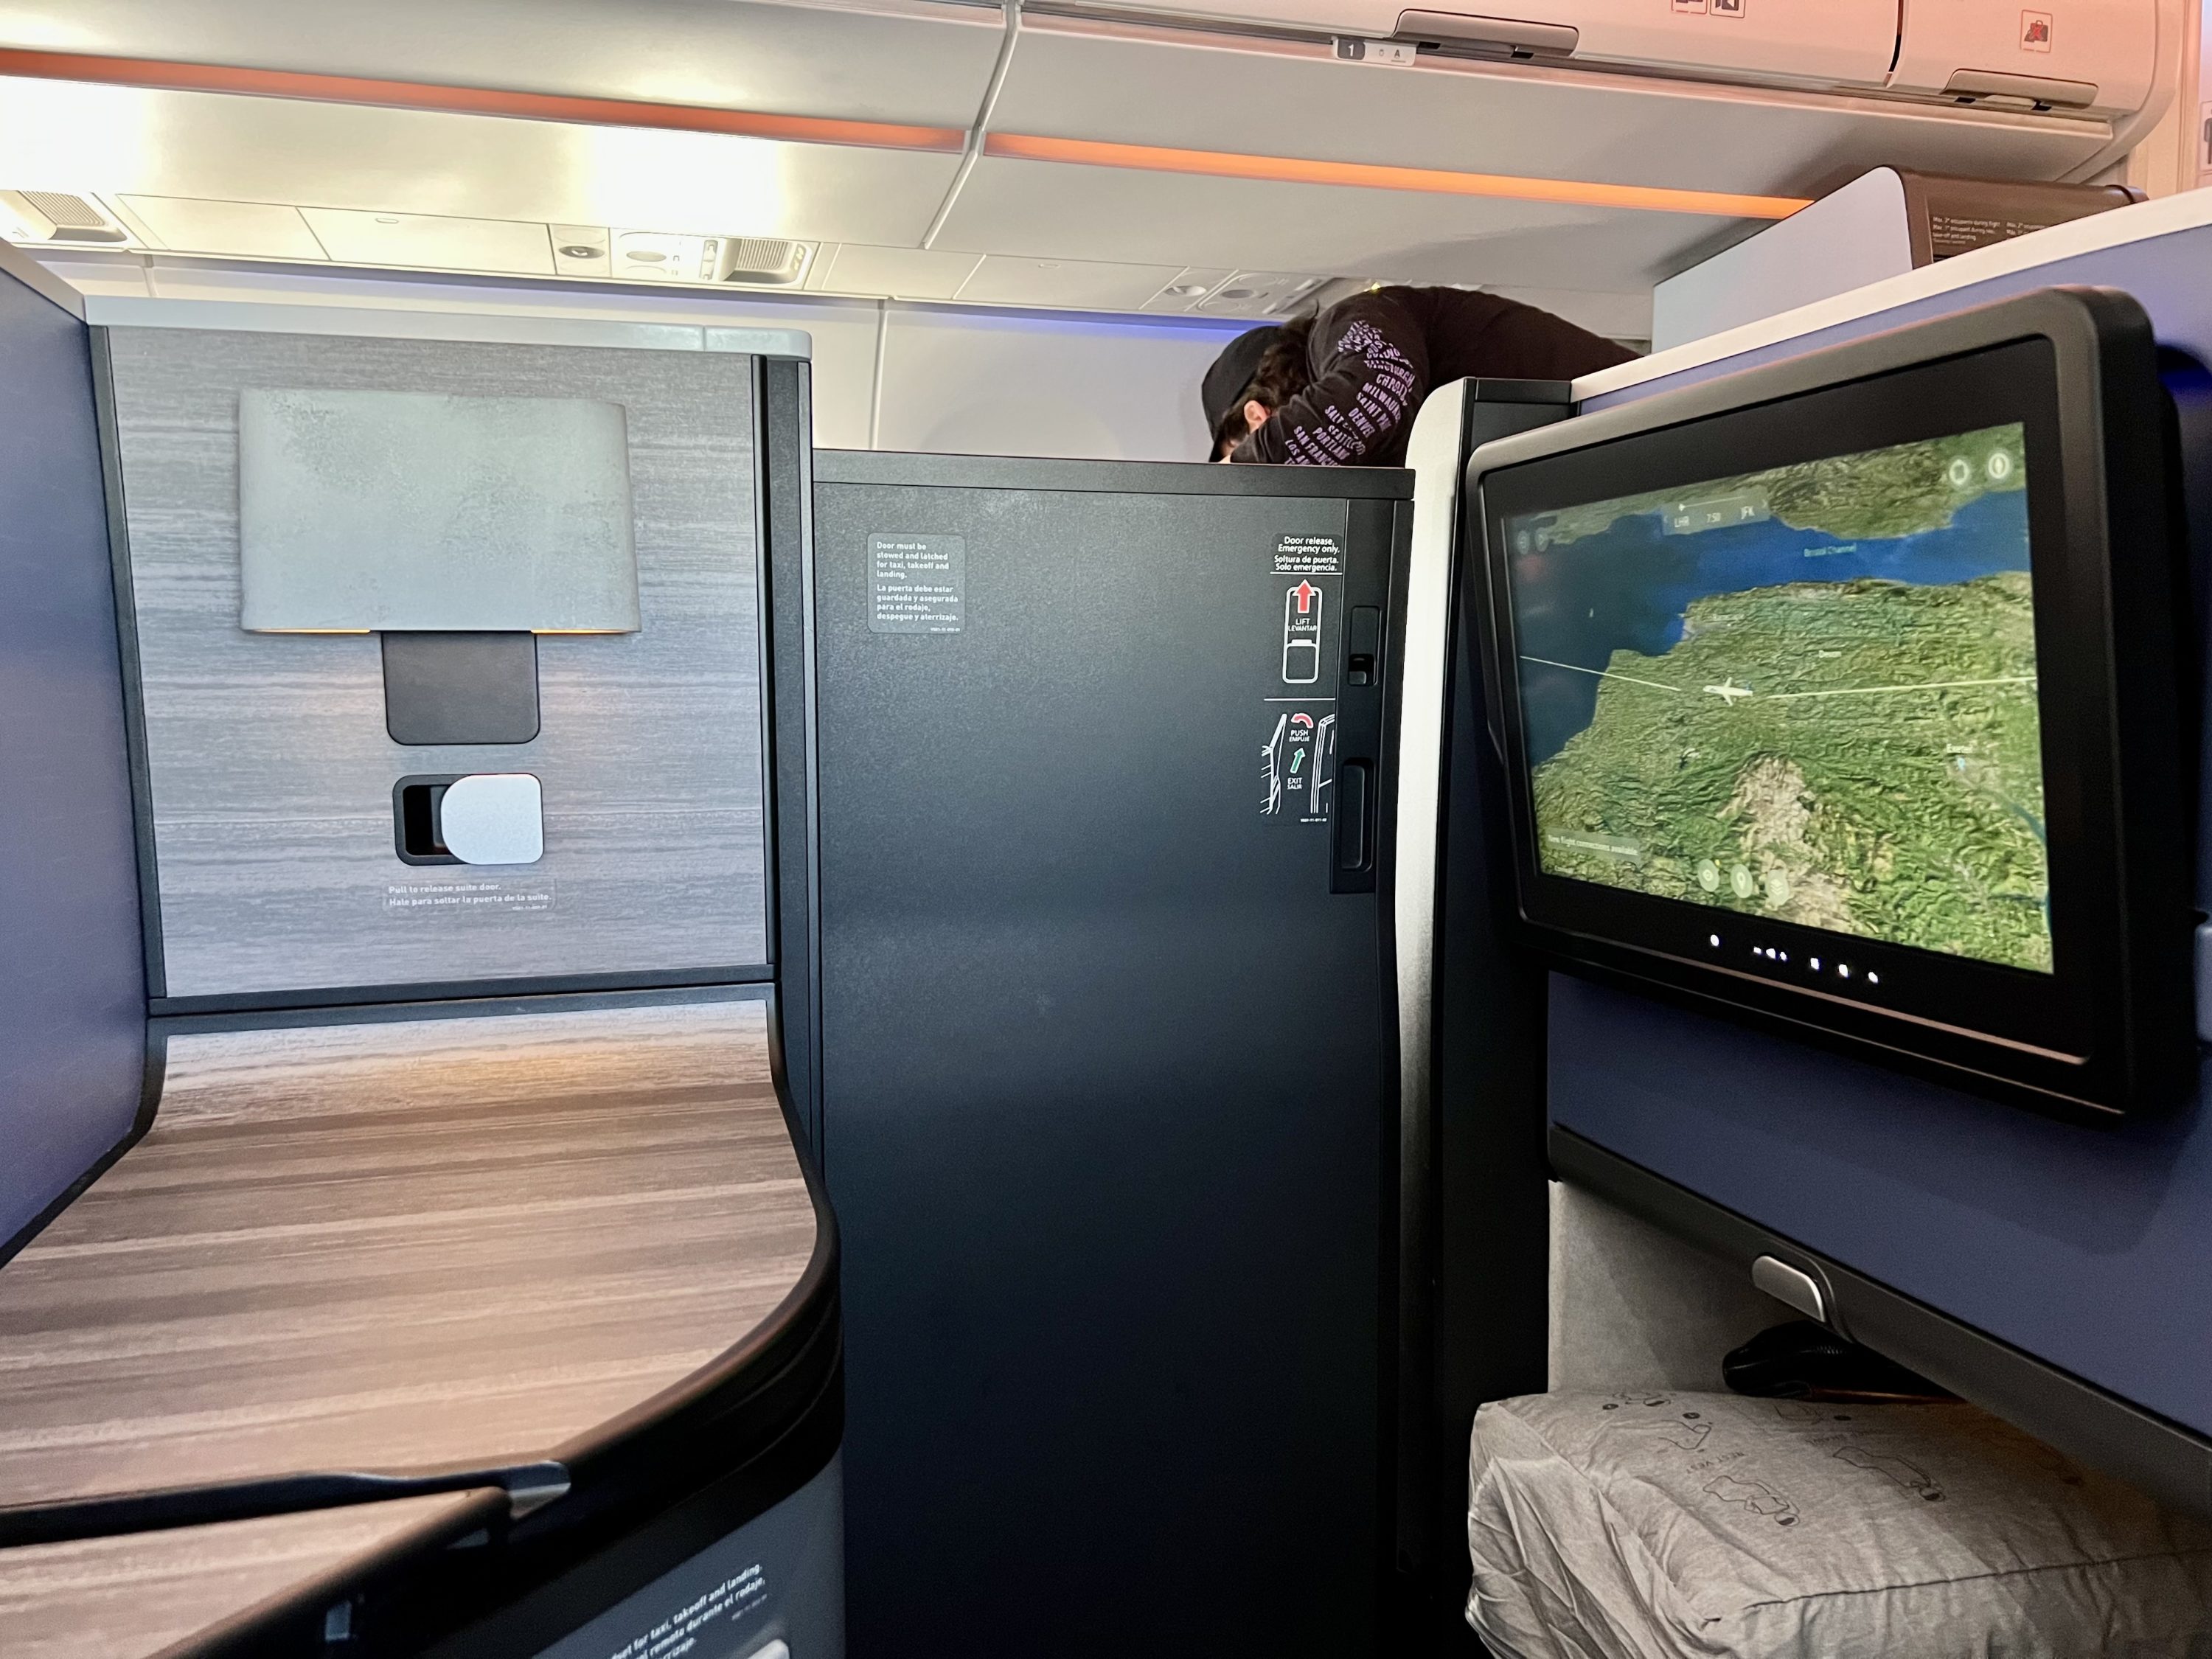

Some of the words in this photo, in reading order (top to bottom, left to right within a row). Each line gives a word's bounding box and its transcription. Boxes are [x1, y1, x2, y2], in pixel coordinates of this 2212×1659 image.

[1349, 44, 1354, 57] 1
[1356, 392, 1382, 418] SAINT
[1324, 405, 1345, 424] SALT
[1294, 425, 1310, 446] SAN
[1284, 439, 1301, 456] LOS
[877, 541, 895, 549] Door
[1284, 536, 1304, 545] Door
[1278, 543, 1321, 554] Emergency
[1321, 543, 1340, 554] only.
[877, 552, 904, 560] stowed
[920, 552, 948, 560] latched
[1274, 554, 1301, 563] Soltura
[1301, 555, 1312, 563] de
[1312, 557, 1339, 565] puerta.
[889, 561, 906, 569] taxi,
[907, 561, 934, 569] takeoff
[935, 562, 950, 570] and
[1276, 563, 1292, 571] Solo
[1293, 563, 1338, 573] emergencia.
[877, 570, 908, 580] landing.
[877, 584, 886, 592] La
[888, 585, 913, 593] puerta
[914, 585, 933, 593] debe
[877, 594, 912, 602] guardada
[914, 595, 919, 603] y
[919, 595, 959, 604] asegurada
[877, 603, 894, 612] para
[895, 603, 904, 611] el
[905, 604, 931, 613] rodaje,
[877, 613, 914, 622] despegue
[914, 613, 919, 622] y
[920, 613, 959, 622] aterrizaje.
[389, 886, 407, 894] Pull
[420, 885, 454, 893] release
[455, 883, 477, 891] suite
[479, 883, 501, 891] door.
[389, 898, 409, 906] Hale
[412, 899, 432, 907] para
[434, 897, 461, 905] soltar
[462, 895, 471, 903] la
[473, 895, 503, 905] puerta
[504, 894, 515, 902] de
[527, 893, 552, 901] suite.
[633, 1633, 649, 1651] for
[673, 1594, 707, 1625] takeoff
[709, 1582, 726, 1601] and
[686, 1603, 723, 1632] durante
[724, 1593, 734, 1607] el
